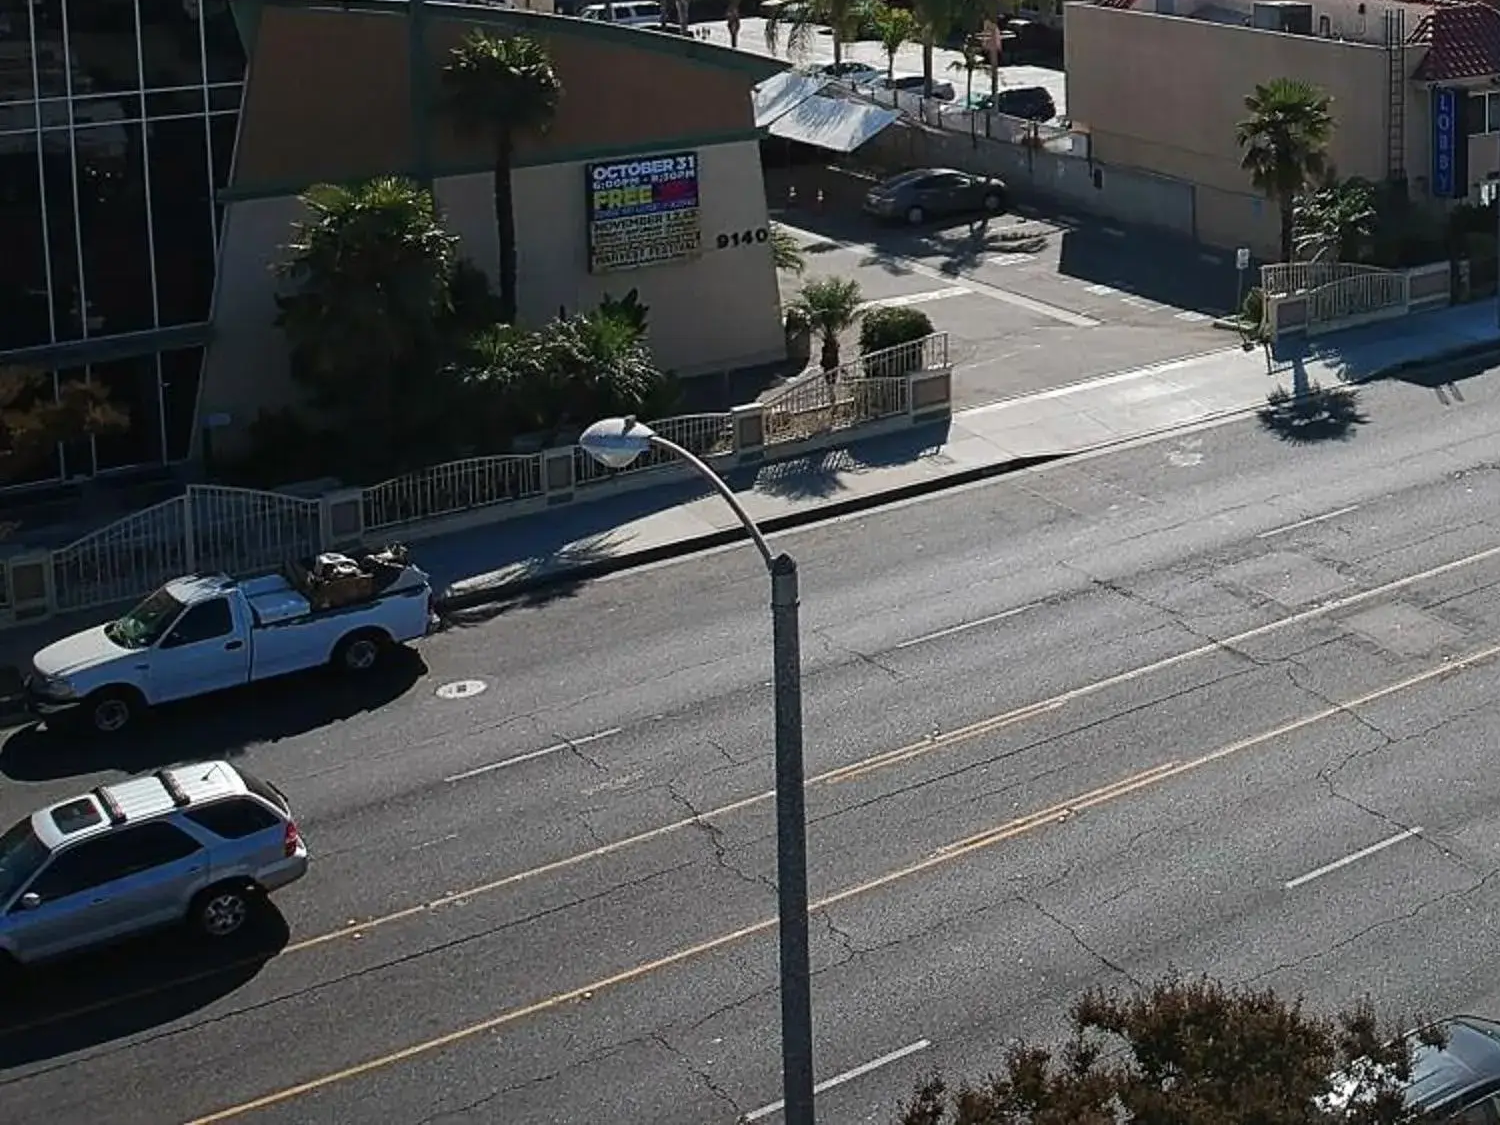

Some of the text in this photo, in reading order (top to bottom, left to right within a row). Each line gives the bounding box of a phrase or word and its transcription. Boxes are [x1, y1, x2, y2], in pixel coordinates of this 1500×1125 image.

[1438, 95, 1449, 191] LOBBY
[593, 156, 695, 180] OCTOBER 31
[594, 185, 653, 208] FREE
[716, 228, 768, 249] 9140
